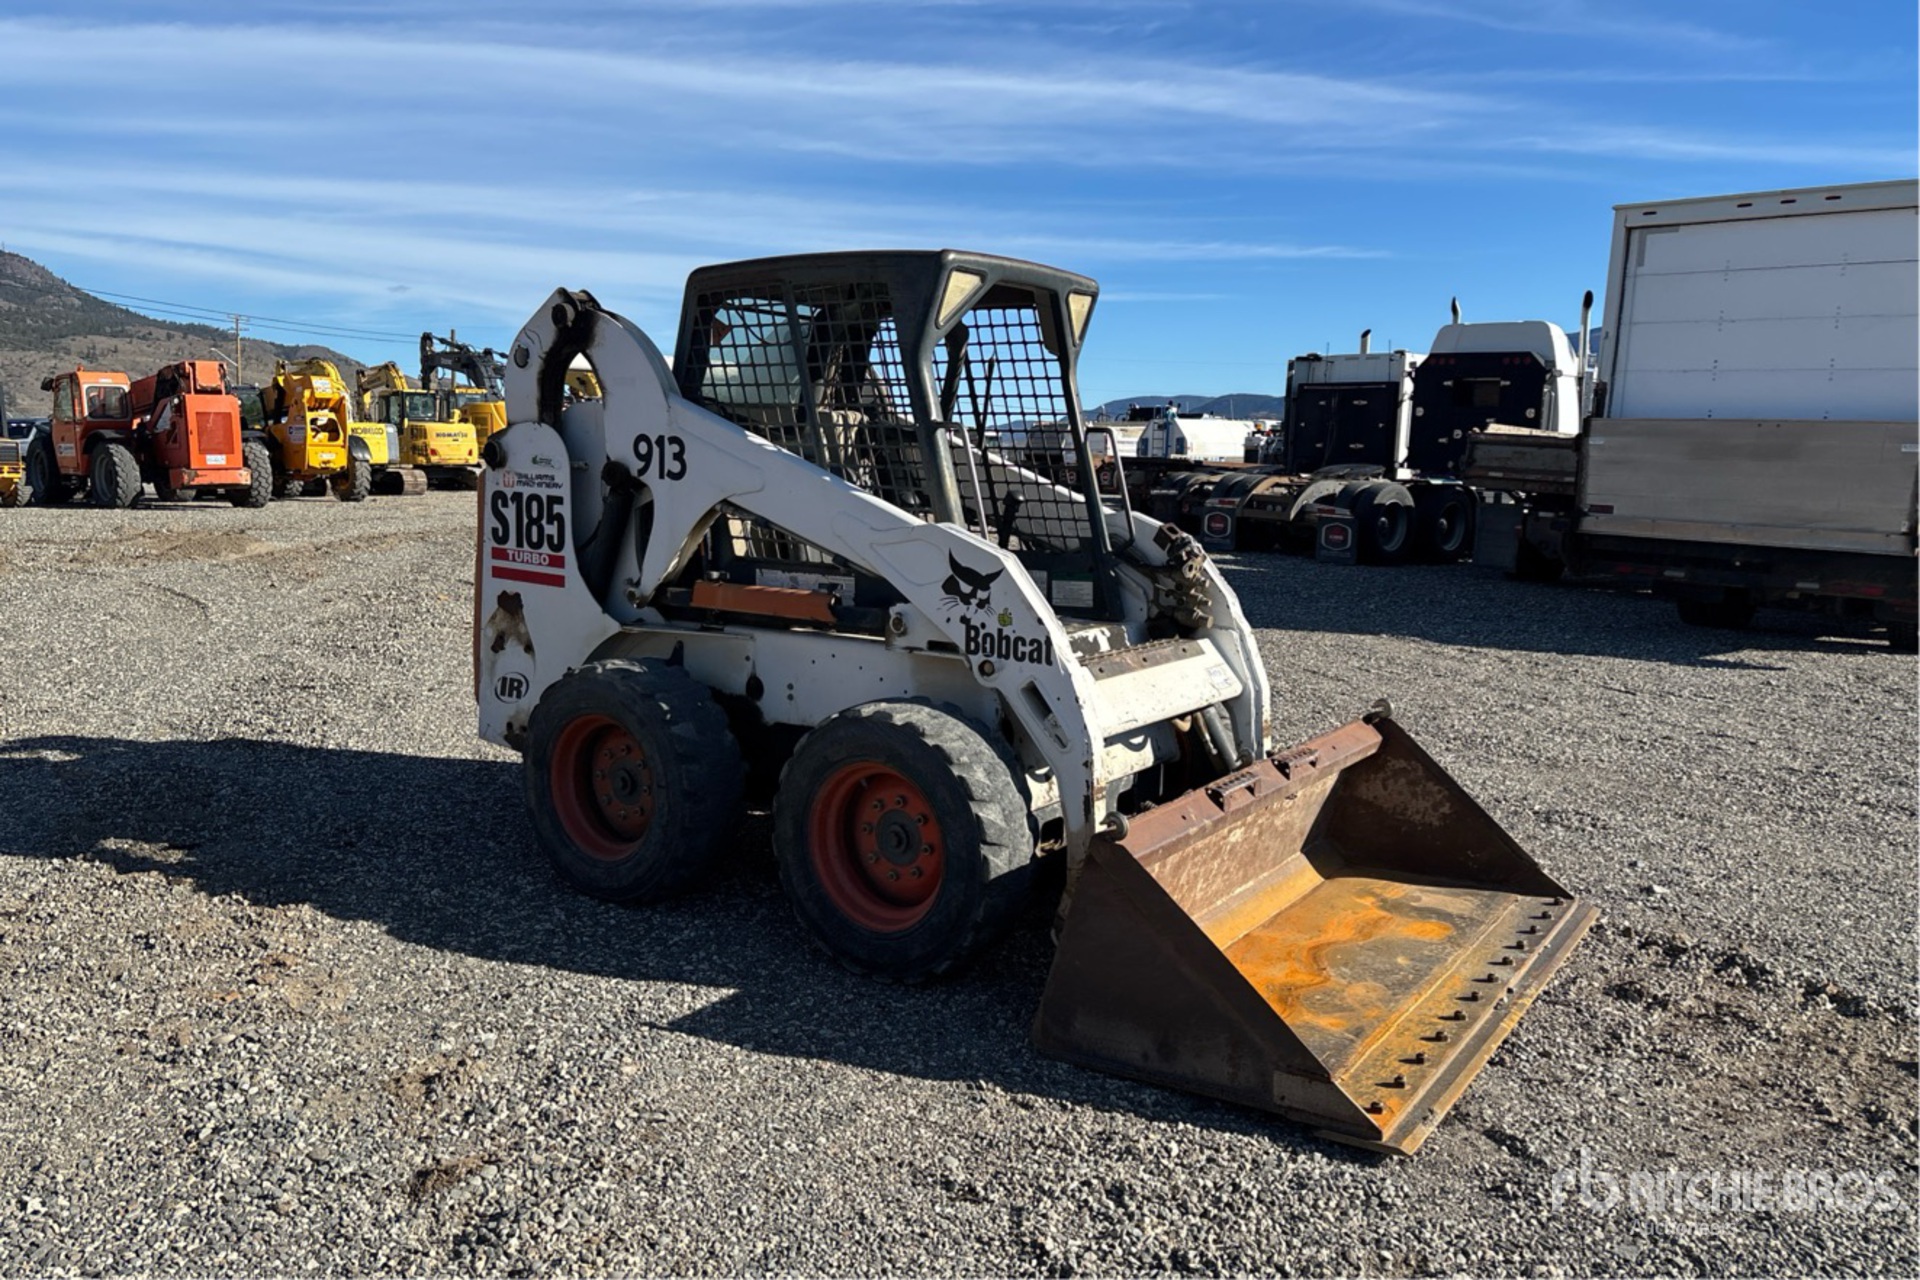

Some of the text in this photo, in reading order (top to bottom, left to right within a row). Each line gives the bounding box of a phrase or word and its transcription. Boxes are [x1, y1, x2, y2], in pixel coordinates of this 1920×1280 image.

[633, 434, 687, 481] 913
[491, 490, 565, 552] S185
[506, 550, 549, 566] TURBO
[966, 624, 1053, 666] Bobcat
[500, 676, 524, 698] IR
